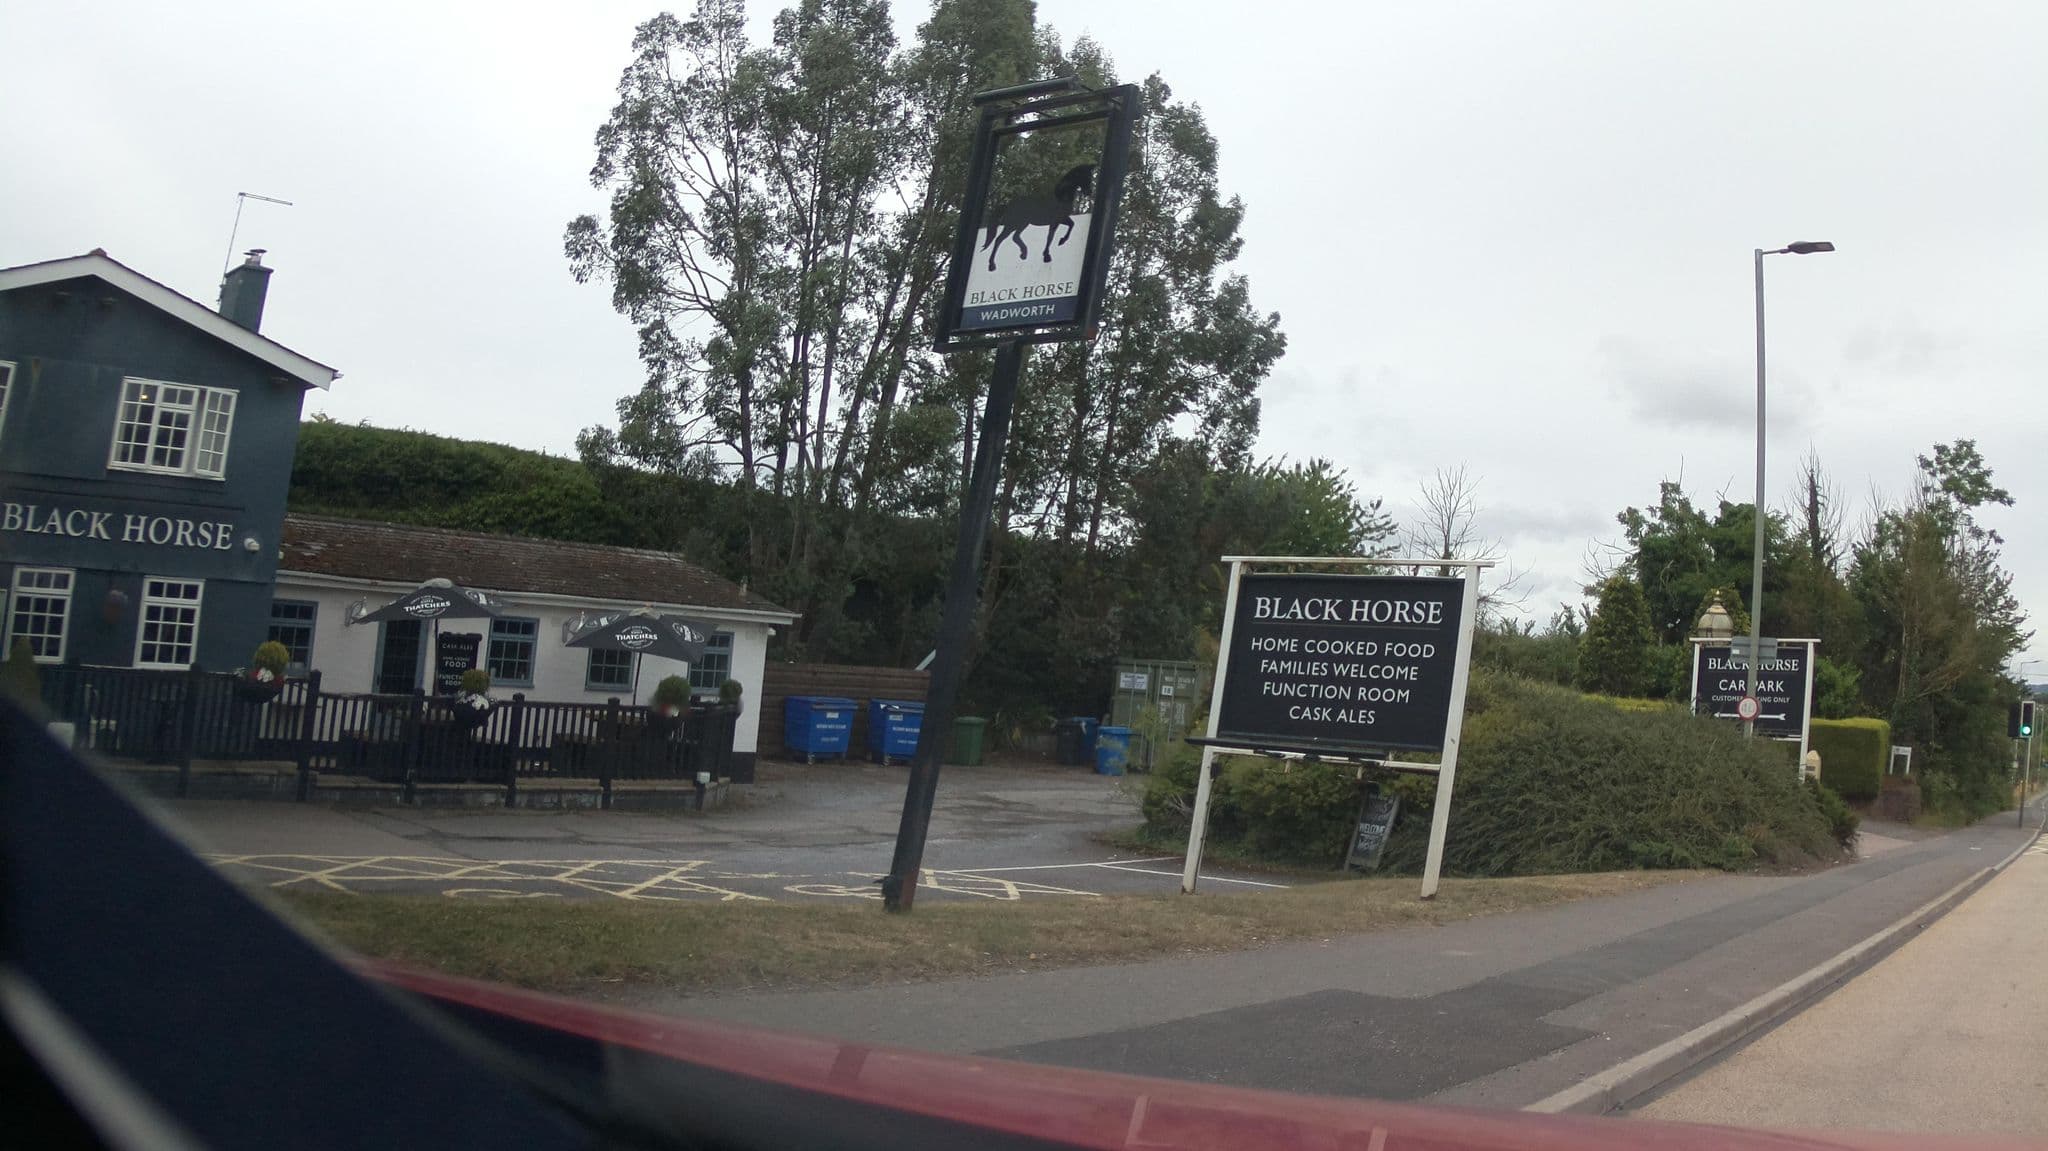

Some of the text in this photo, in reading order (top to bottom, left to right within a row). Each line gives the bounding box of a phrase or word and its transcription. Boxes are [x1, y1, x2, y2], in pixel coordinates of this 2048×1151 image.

[970, 282, 1073, 304] BLACK HORSE
[981, 304, 1055, 321] WADWORTH
[2, 503, 233, 550] BLACK HORSE
[403, 600, 451, 612] THATCHERS
[1254, 597, 1443, 624] BLACK HORSE
[1251, 637, 1435, 658] HOME COOKED FOOD
[445, 660, 467, 668] FOOD
[1260, 659, 1419, 681] FAMILIES WELCOME
[1263, 681, 1410, 703] FUNCTION ROOM
[1718, 679, 1784, 692] CAR ARK
[1289, 705, 1376, 724] CASK ALES
